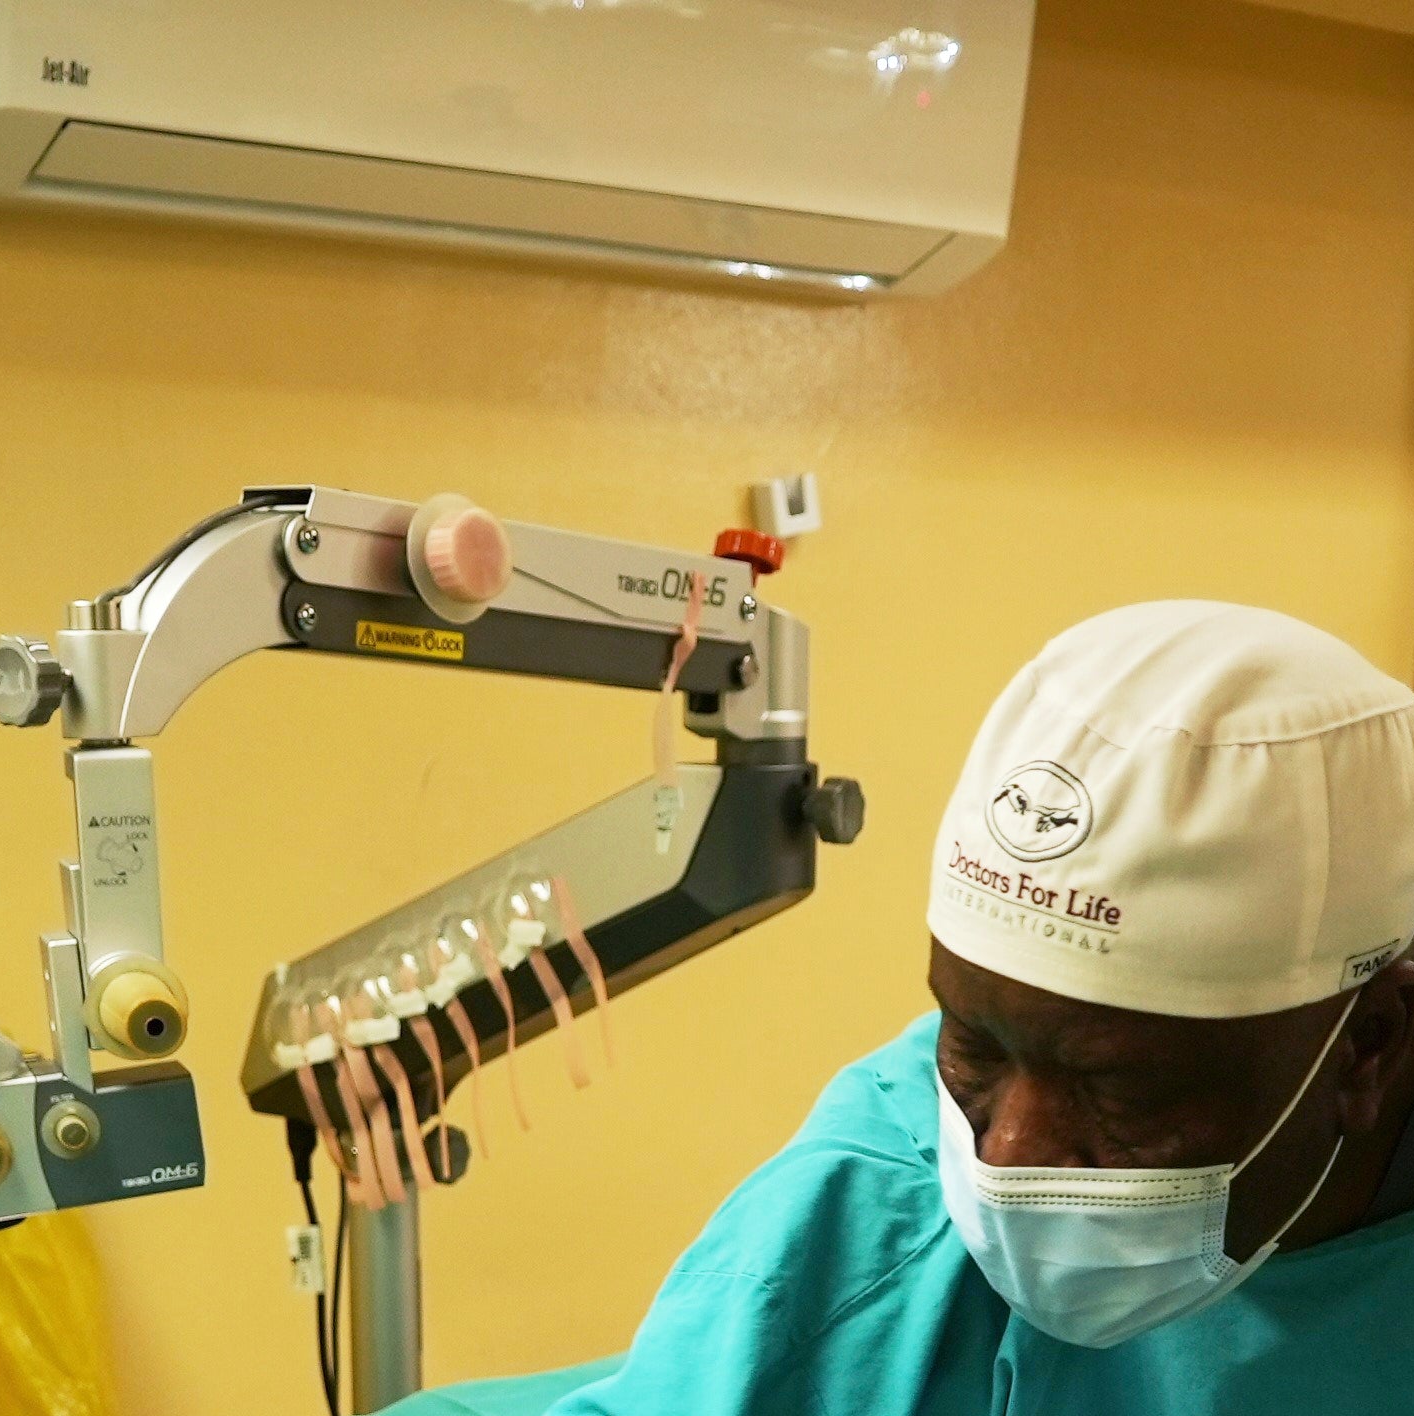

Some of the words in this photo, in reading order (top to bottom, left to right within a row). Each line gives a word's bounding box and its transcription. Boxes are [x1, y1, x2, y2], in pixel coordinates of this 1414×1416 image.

[41, 56, 90, 87] Jet-Air
[437, 637, 462, 651] LOCK
[99, 814, 151, 828] CAUTION
[949, 841, 1011, 894] Doctors
[1016, 873, 1059, 909] For
[1066, 888, 1122, 926] Life
